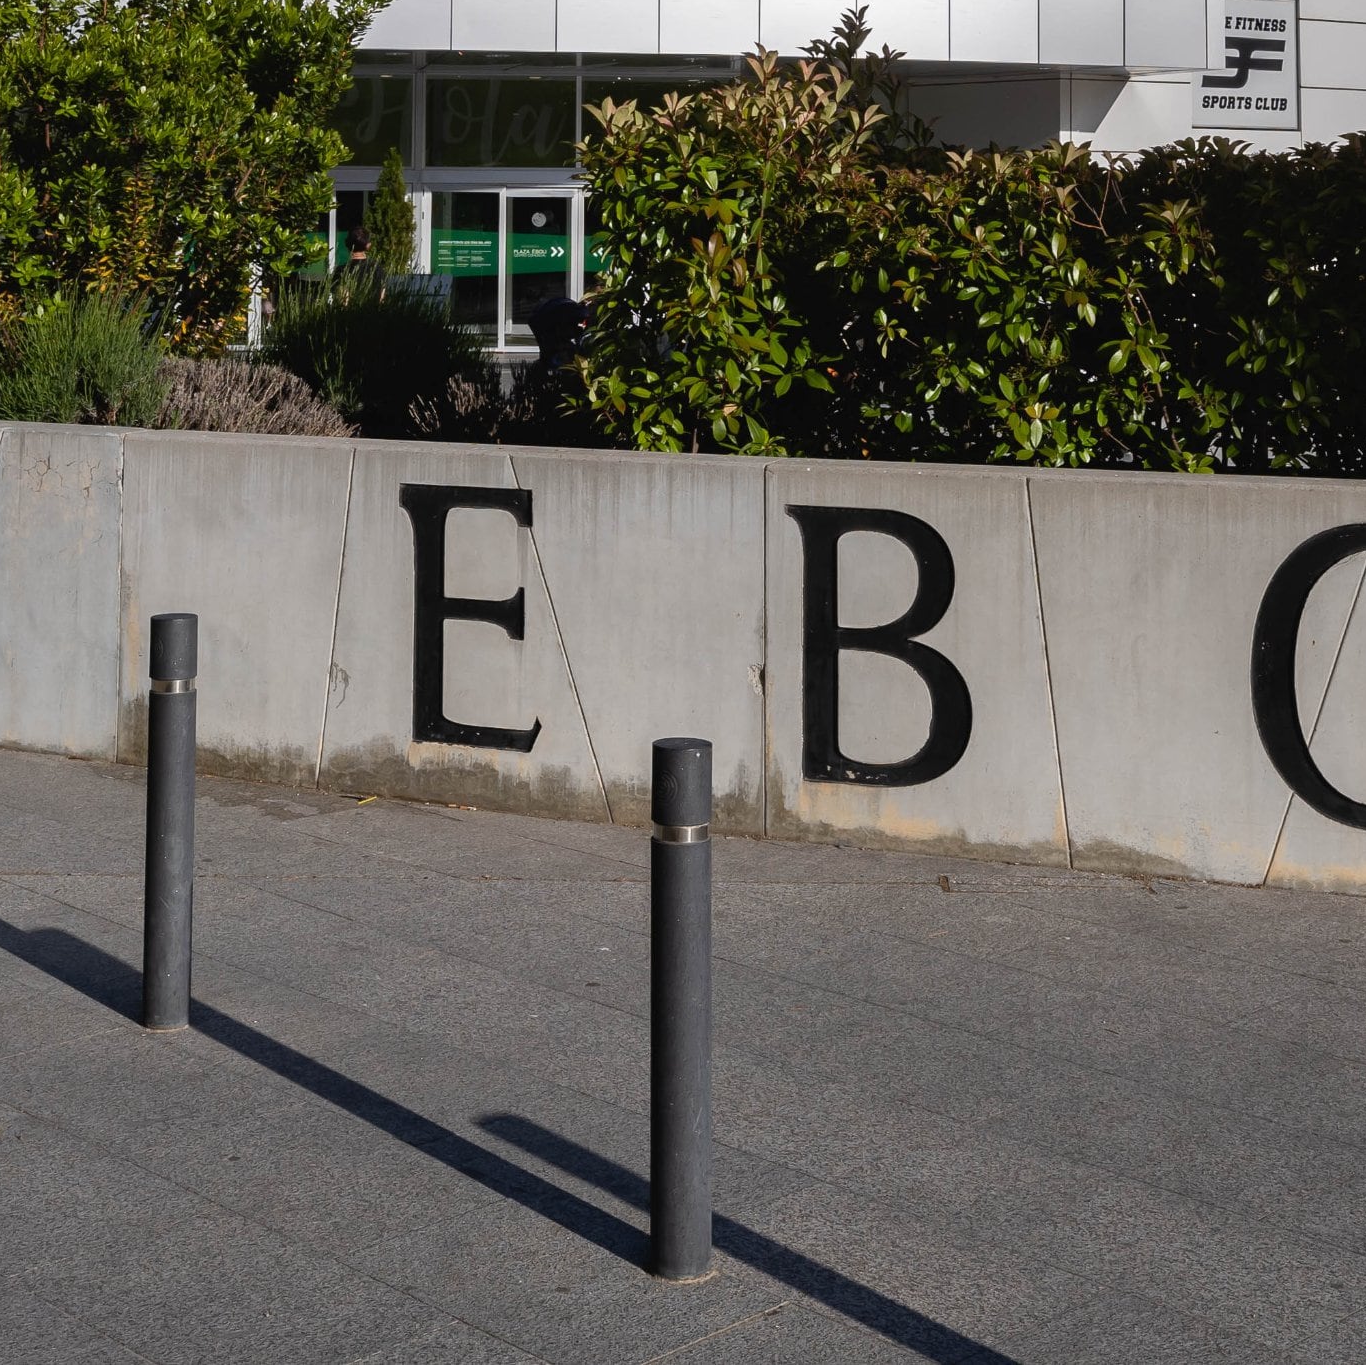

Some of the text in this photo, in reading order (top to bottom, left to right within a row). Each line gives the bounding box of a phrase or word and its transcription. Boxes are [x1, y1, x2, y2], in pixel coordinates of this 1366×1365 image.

[1235, 17, 1287, 33] FITNESS
[1202, 95, 1288, 112] SPORTS CLUB
